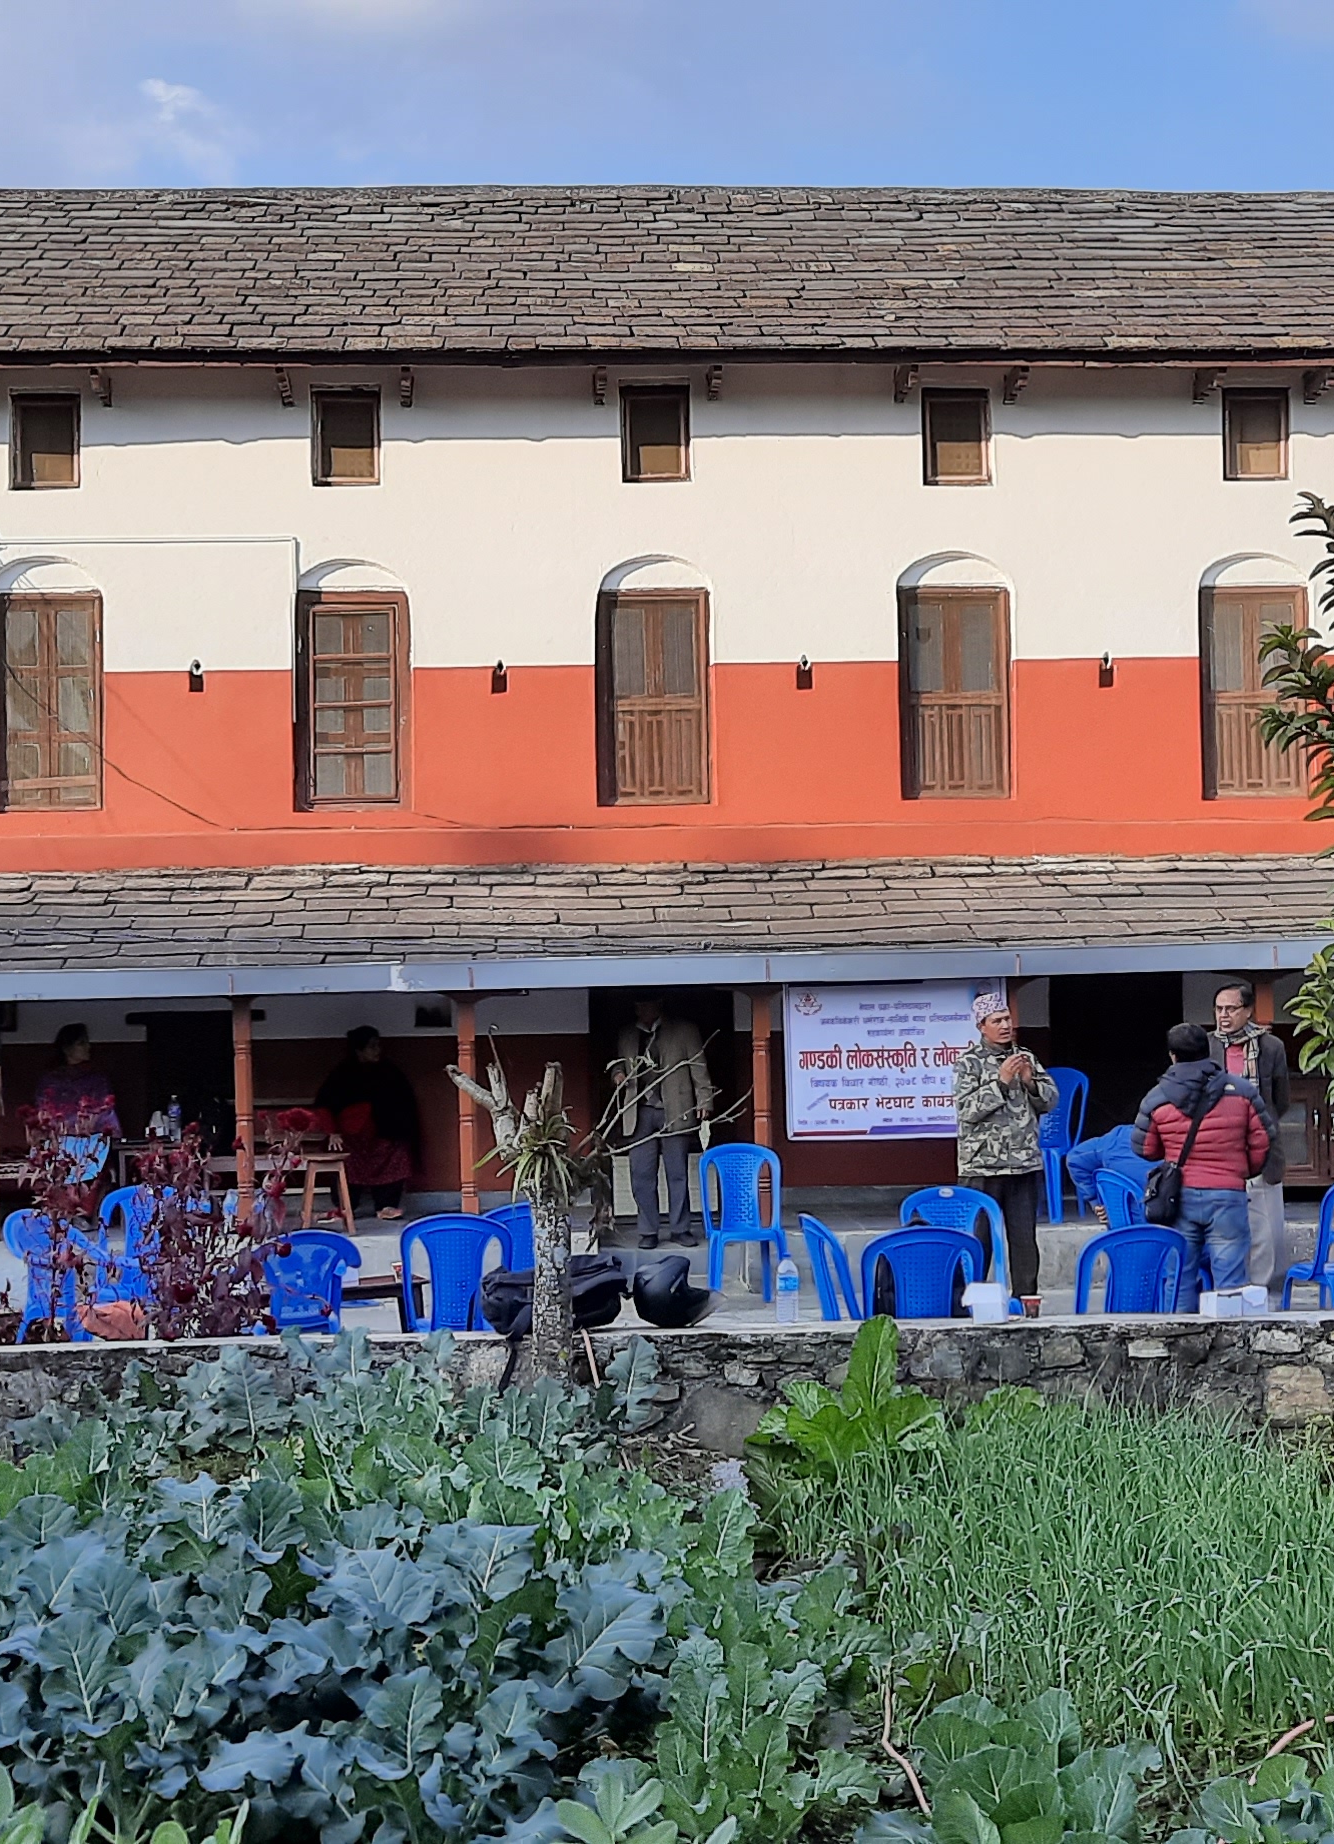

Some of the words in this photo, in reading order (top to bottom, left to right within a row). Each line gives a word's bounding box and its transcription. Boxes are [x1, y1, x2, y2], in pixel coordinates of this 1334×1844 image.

[798, 1043, 842, 1071] गण्डकी
[846, 1041, 917, 1074] लोकसंस्कृति
[920, 1047, 930, 1068] र
[828, 1097, 870, 1111] पत्रकार
[875, 1093, 916, 1110] भेटघाट
[921, 1091, 956, 1108] कार्यक्र
